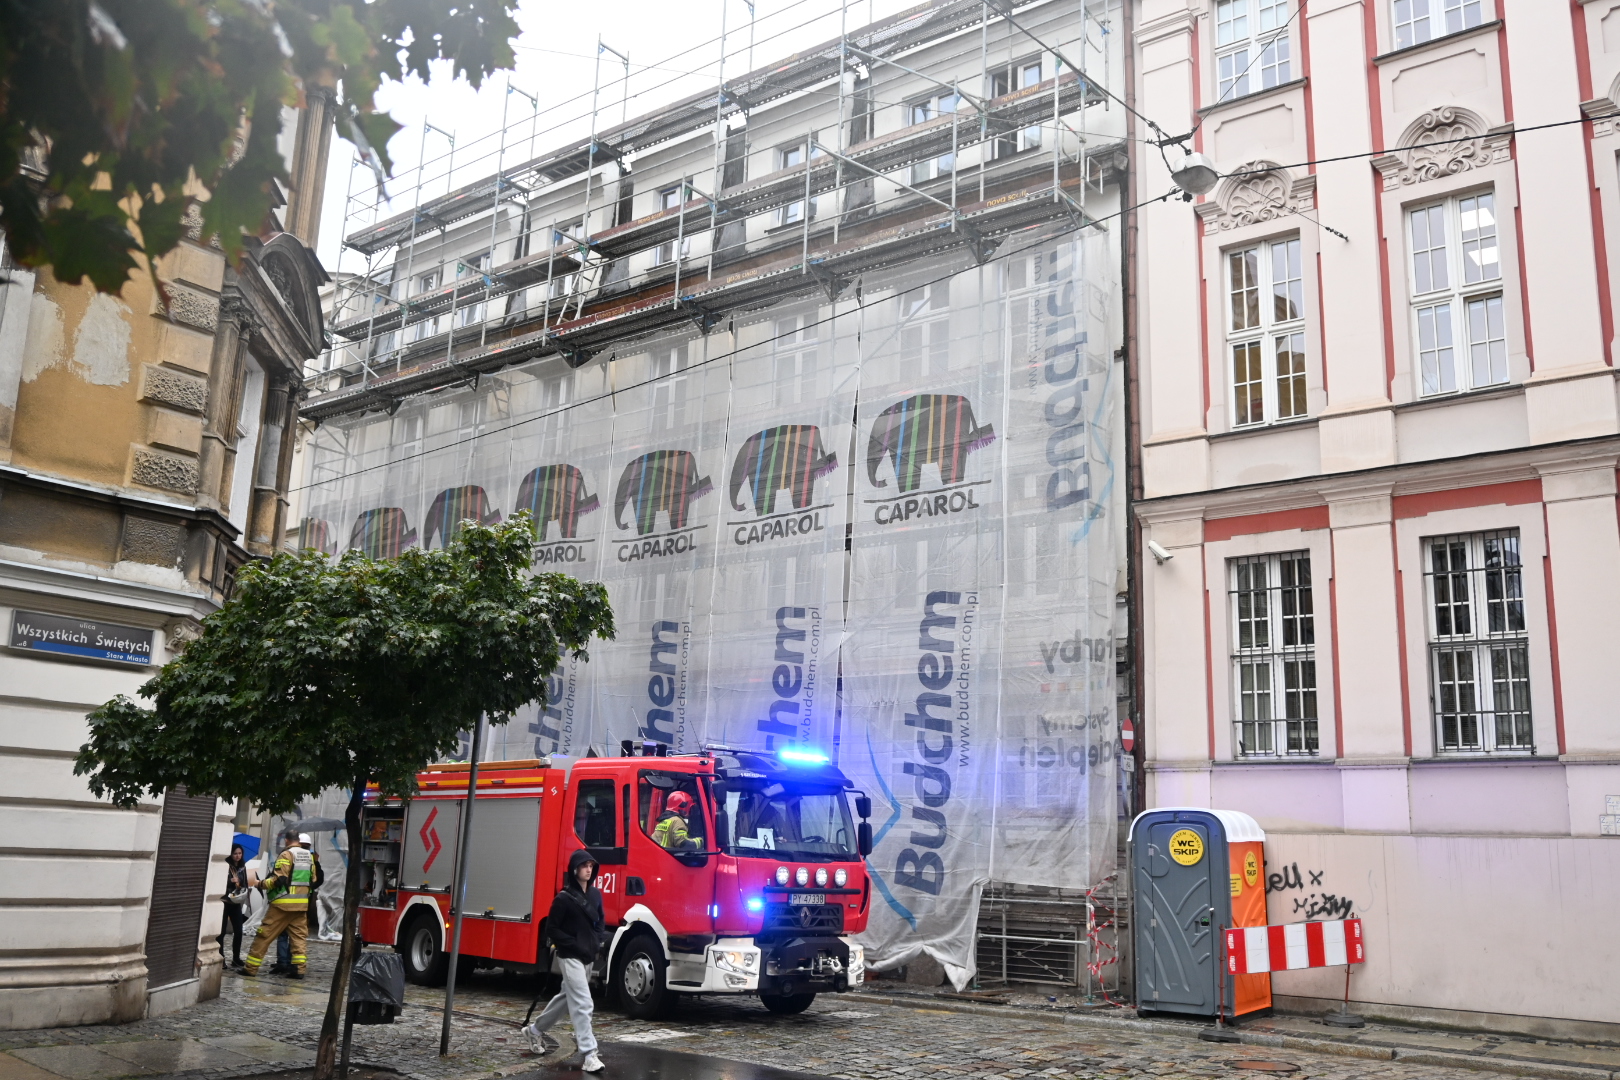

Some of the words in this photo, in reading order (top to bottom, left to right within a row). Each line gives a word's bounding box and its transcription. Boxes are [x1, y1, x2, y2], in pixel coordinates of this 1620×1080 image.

[987, 196, 1006, 207] nova
[874, 488, 980, 525] CAPAROL
[734, 512, 824, 546] CAPAROL
[533, 544, 587, 567] PAROL
[617, 534, 697, 563] CAPAROL
[17, 622, 88, 644] Wszystkich
[95, 631, 150, 653] Świętych
[106, 651, 124, 660] Stare
[127, 654, 149, 663] Miasto
[958, 590, 978, 767] www.budchem.com.pl
[894, 590, 961, 896] Budchem
[793, 894, 801, 904] PY
